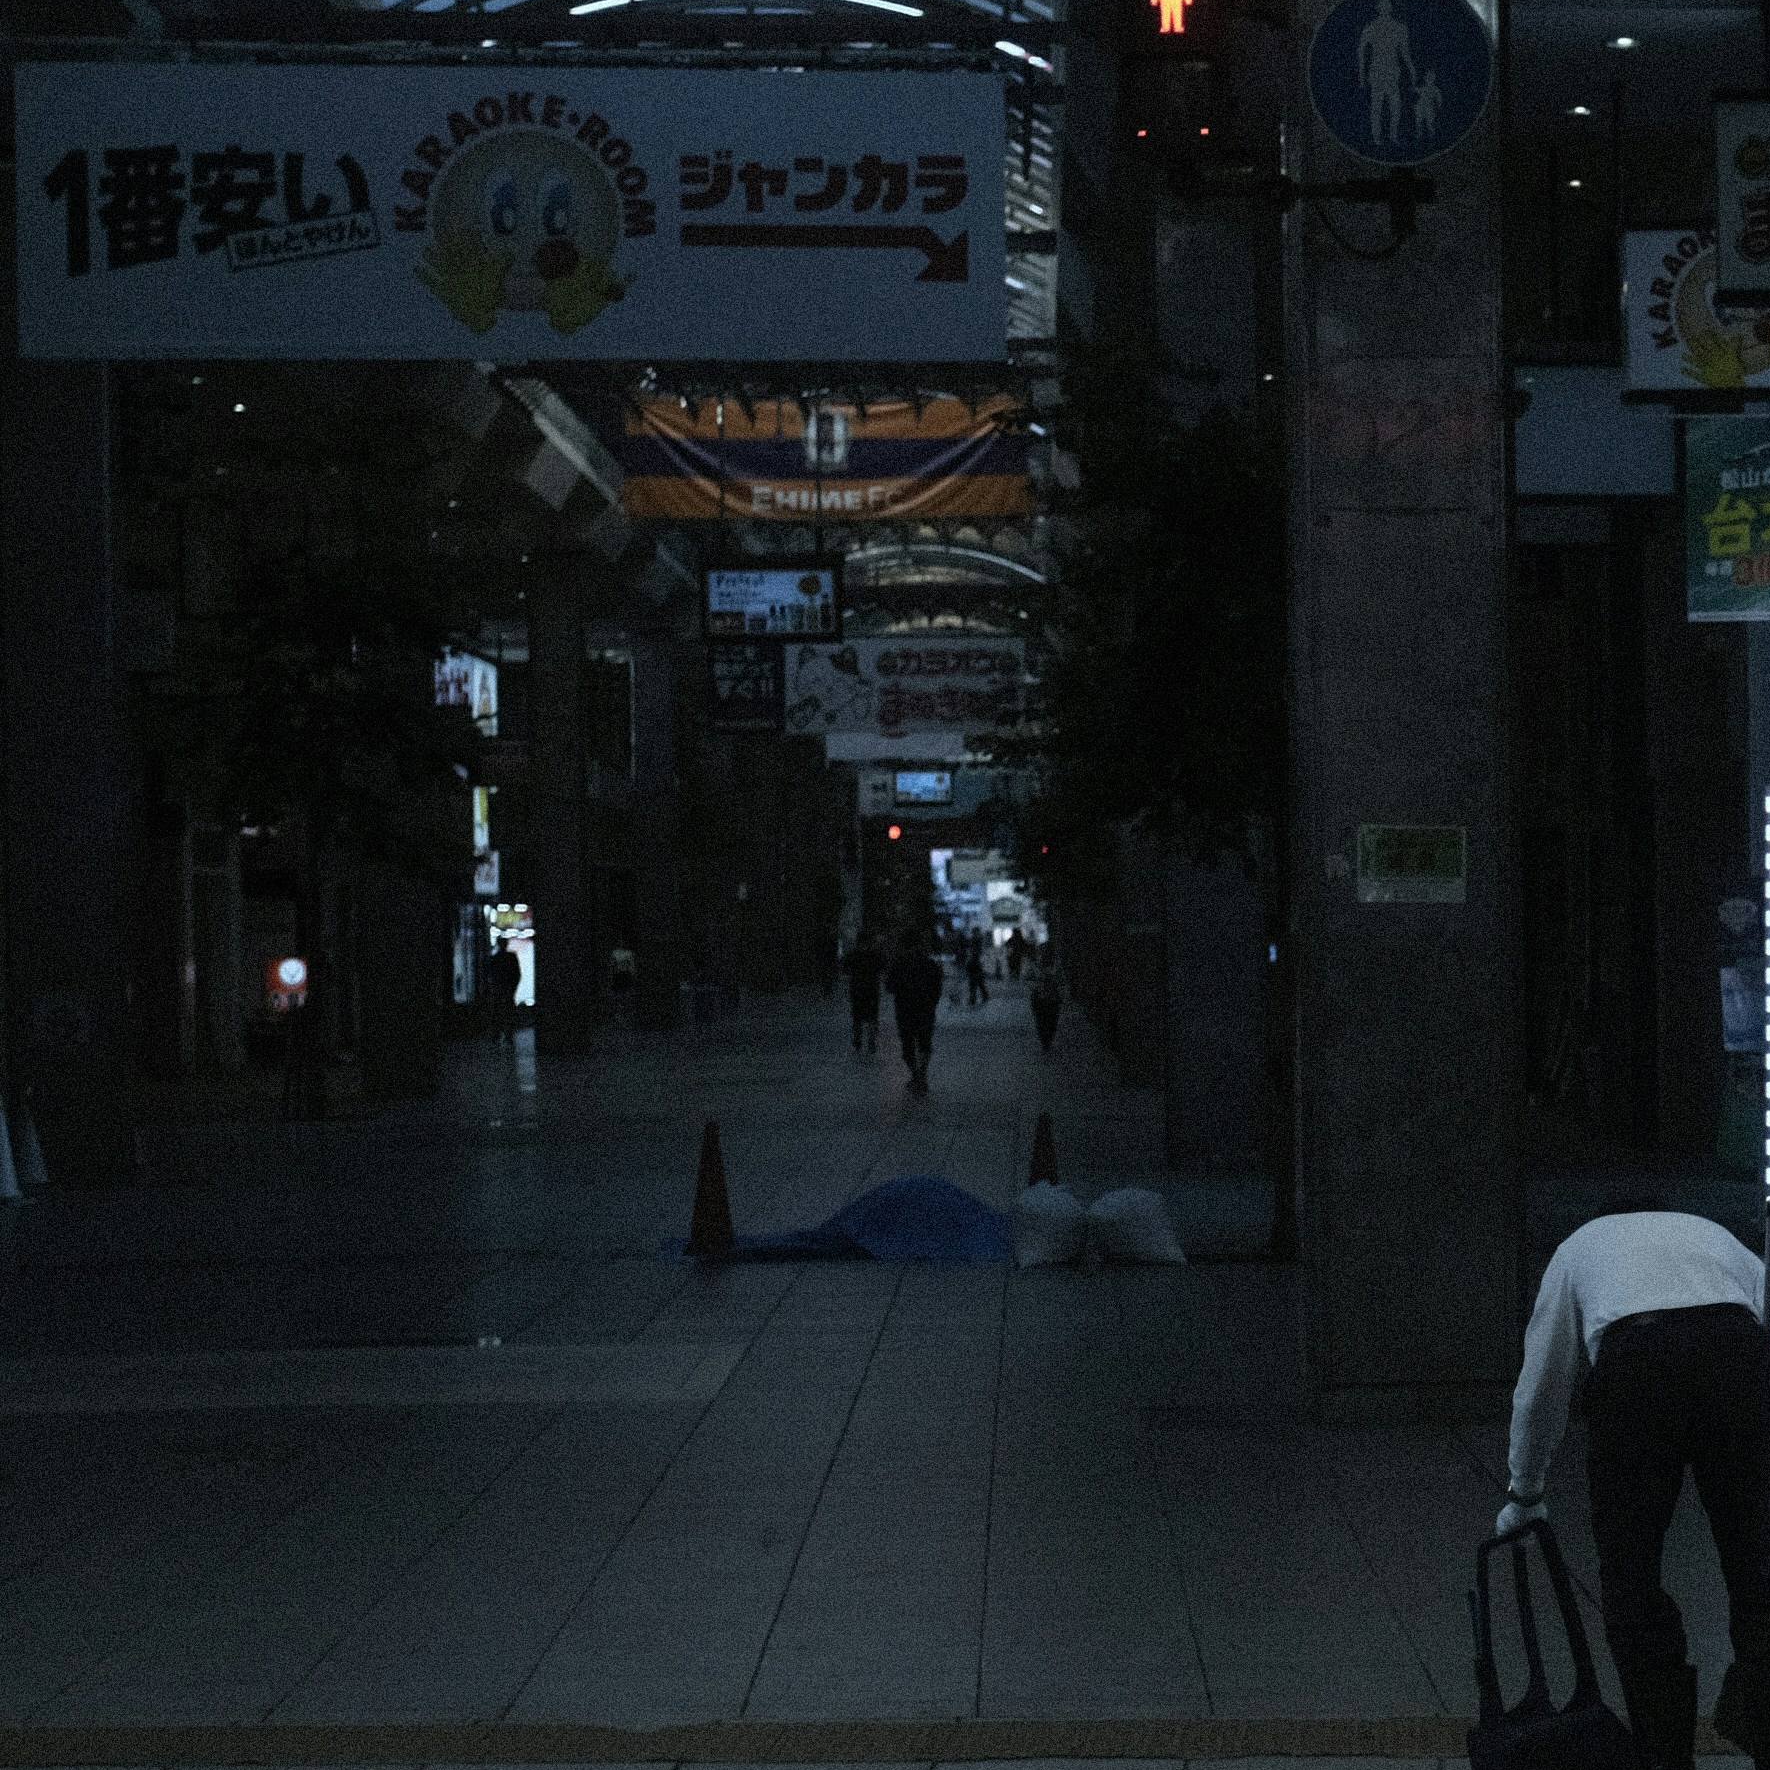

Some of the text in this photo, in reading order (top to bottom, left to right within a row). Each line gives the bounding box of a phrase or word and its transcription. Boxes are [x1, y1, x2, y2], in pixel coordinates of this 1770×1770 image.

[395, 91, 566, 231] KARAOKE
[678, 152, 971, 214] ジャンカラ
[43, 144, 371, 277] 1番安い
[750, 485, 863, 512] EHIME
[896, 649, 996, 675] カラオケ
